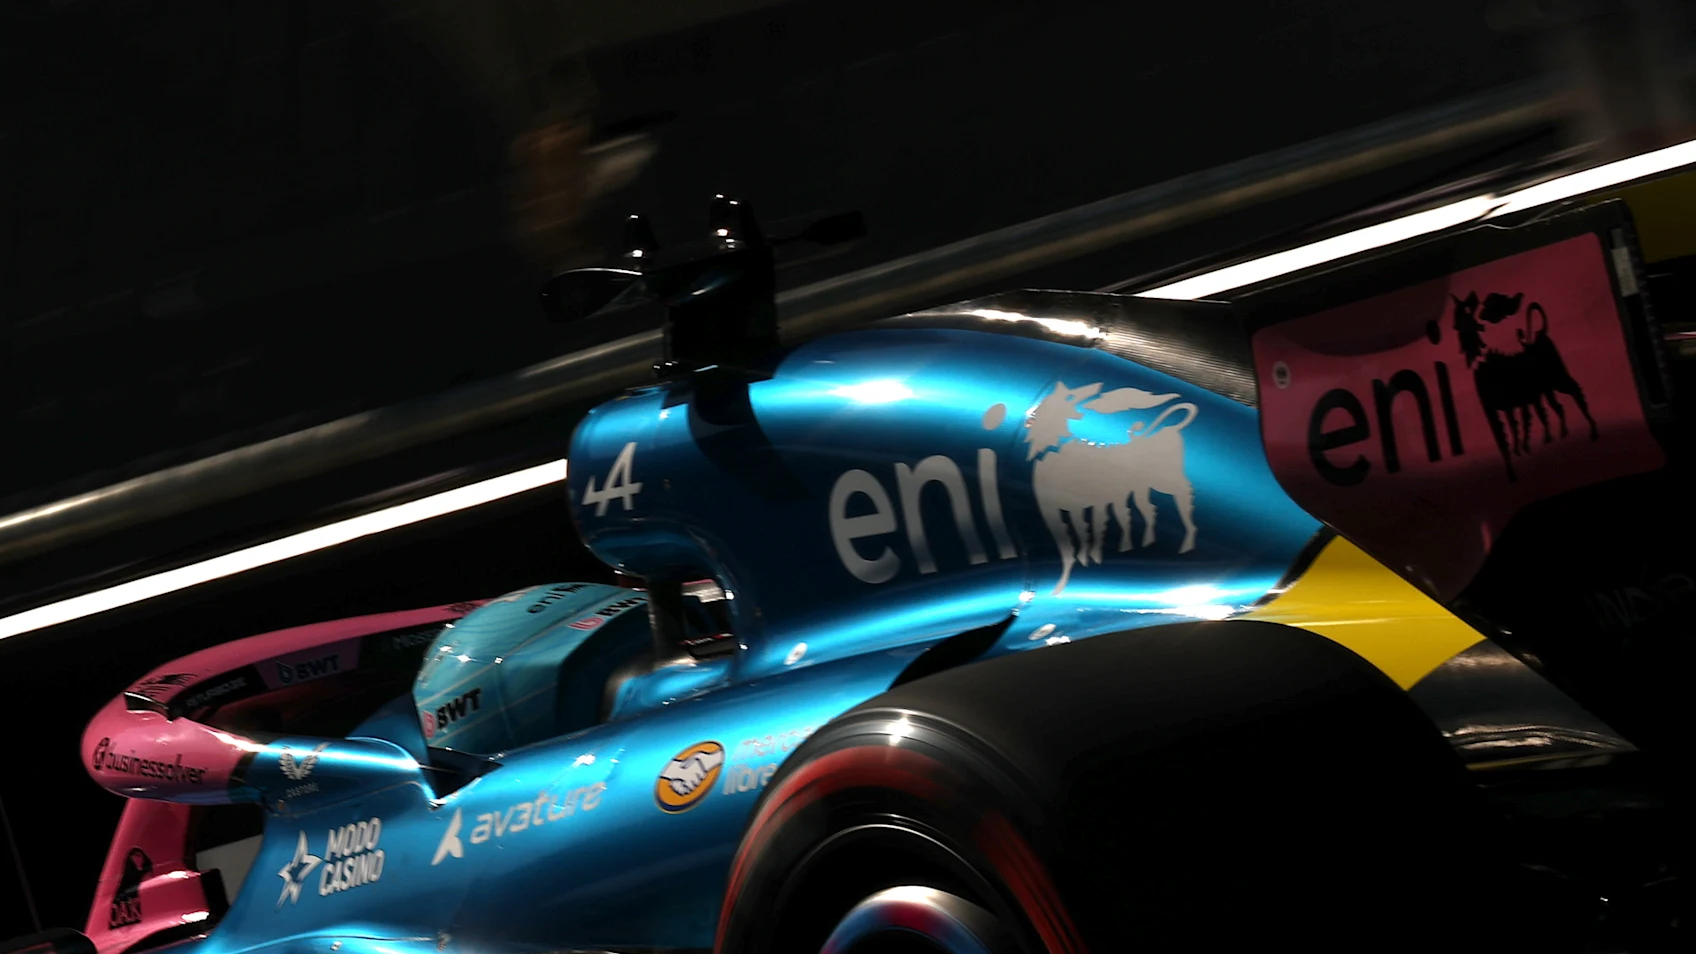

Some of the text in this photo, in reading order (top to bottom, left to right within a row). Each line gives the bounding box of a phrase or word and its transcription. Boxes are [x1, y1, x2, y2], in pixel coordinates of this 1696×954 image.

[1307, 319, 1464, 487] eni
[829, 403, 1018, 585] eni
[296, 654, 340, 683] BWT
[436, 688, 482, 729] BWT
[105, 743, 207, 784] businessolver
[327, 817, 381, 861] MODO
[319, 849, 384, 897] CASINO
